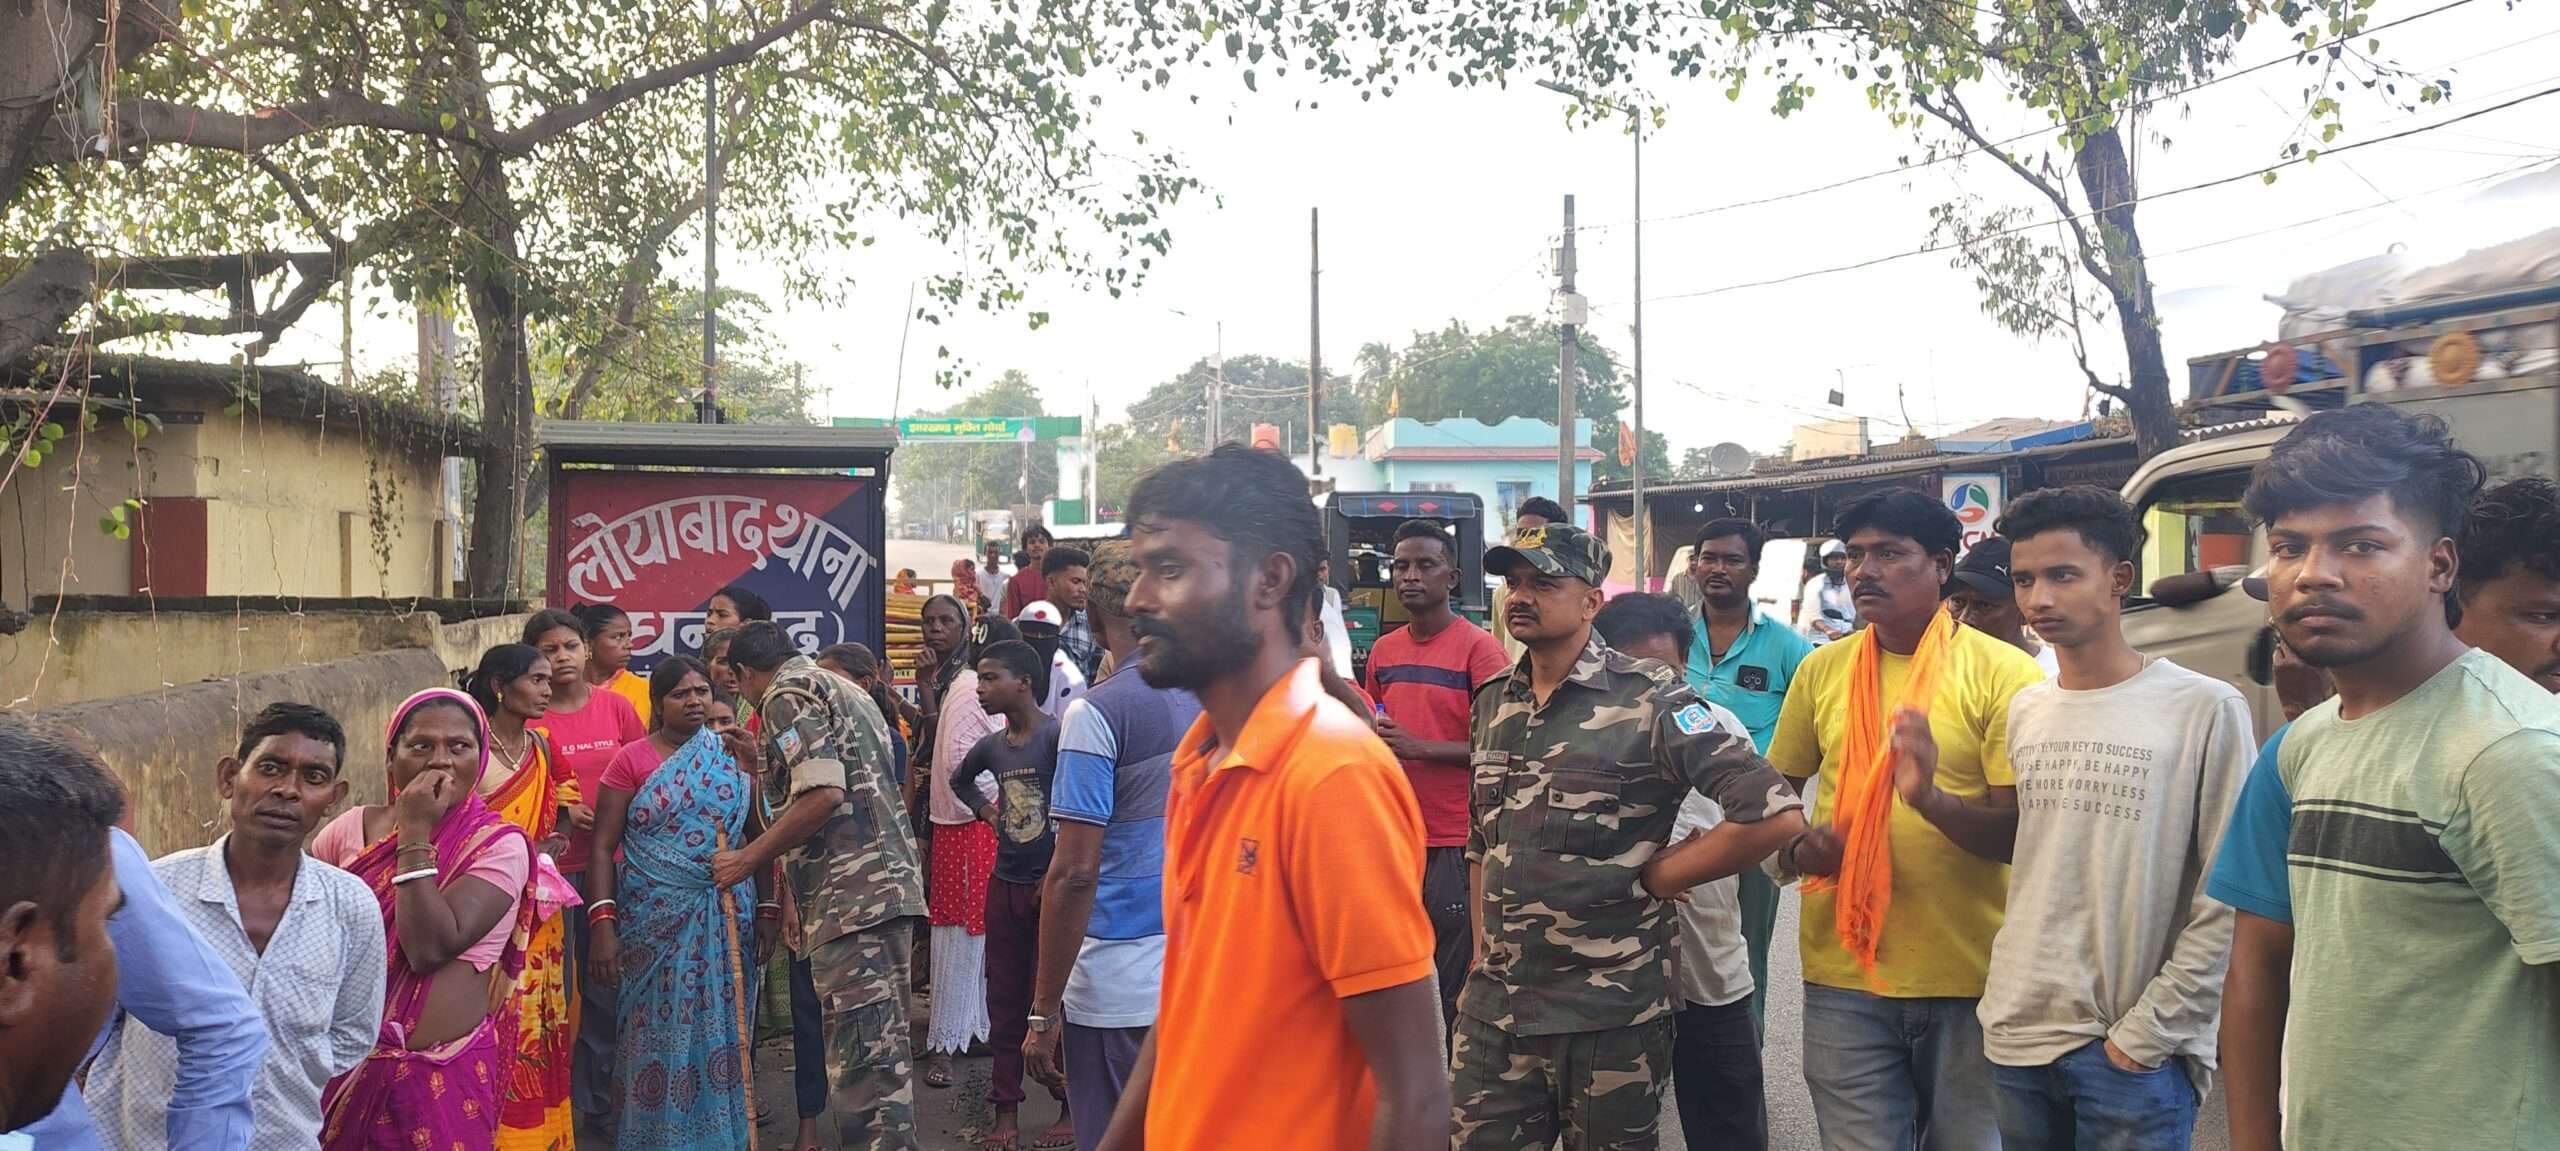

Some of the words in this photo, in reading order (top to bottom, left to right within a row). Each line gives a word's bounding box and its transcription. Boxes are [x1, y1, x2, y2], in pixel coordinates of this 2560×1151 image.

[567, 494, 768, 602] लोयाबाद
[767, 503, 877, 611] थाना
[2071, 740, 2090, 753] KEY
[2091, 742, 2104, 754] TO
[2105, 743, 2153, 761] SUCCESS
[2084, 760, 2100, 773] BE
[2104, 761, 2150, 780] HAPPY
[2035, 778, 2064, 791] MORE
[2111, 783, 2146, 801] LESS
[2073, 798, 2142, 822] SUCCESS
